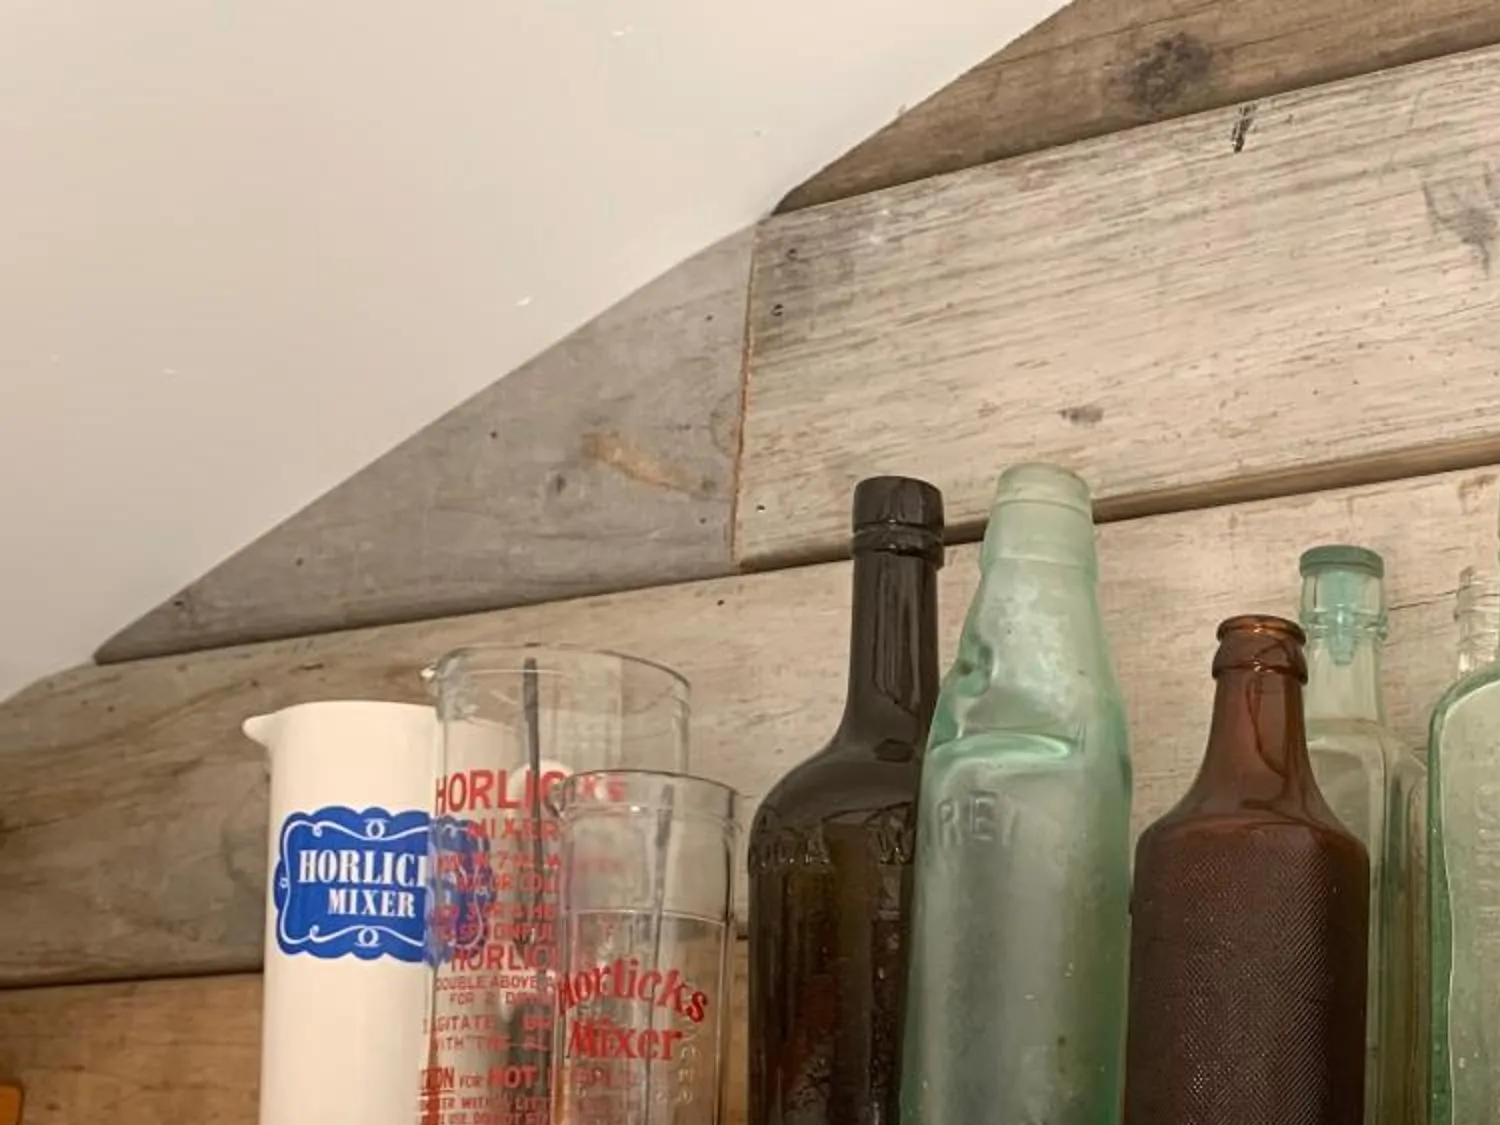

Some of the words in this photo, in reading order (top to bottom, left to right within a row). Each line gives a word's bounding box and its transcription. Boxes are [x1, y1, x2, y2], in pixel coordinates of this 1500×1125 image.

[298, 848, 429, 887] HORLIC
[327, 888, 416, 918] MIXER
[452, 943, 560, 971] HORLIC
[558, 957, 708, 1023] Horlicks
[568, 1018, 683, 1061] Mixer
